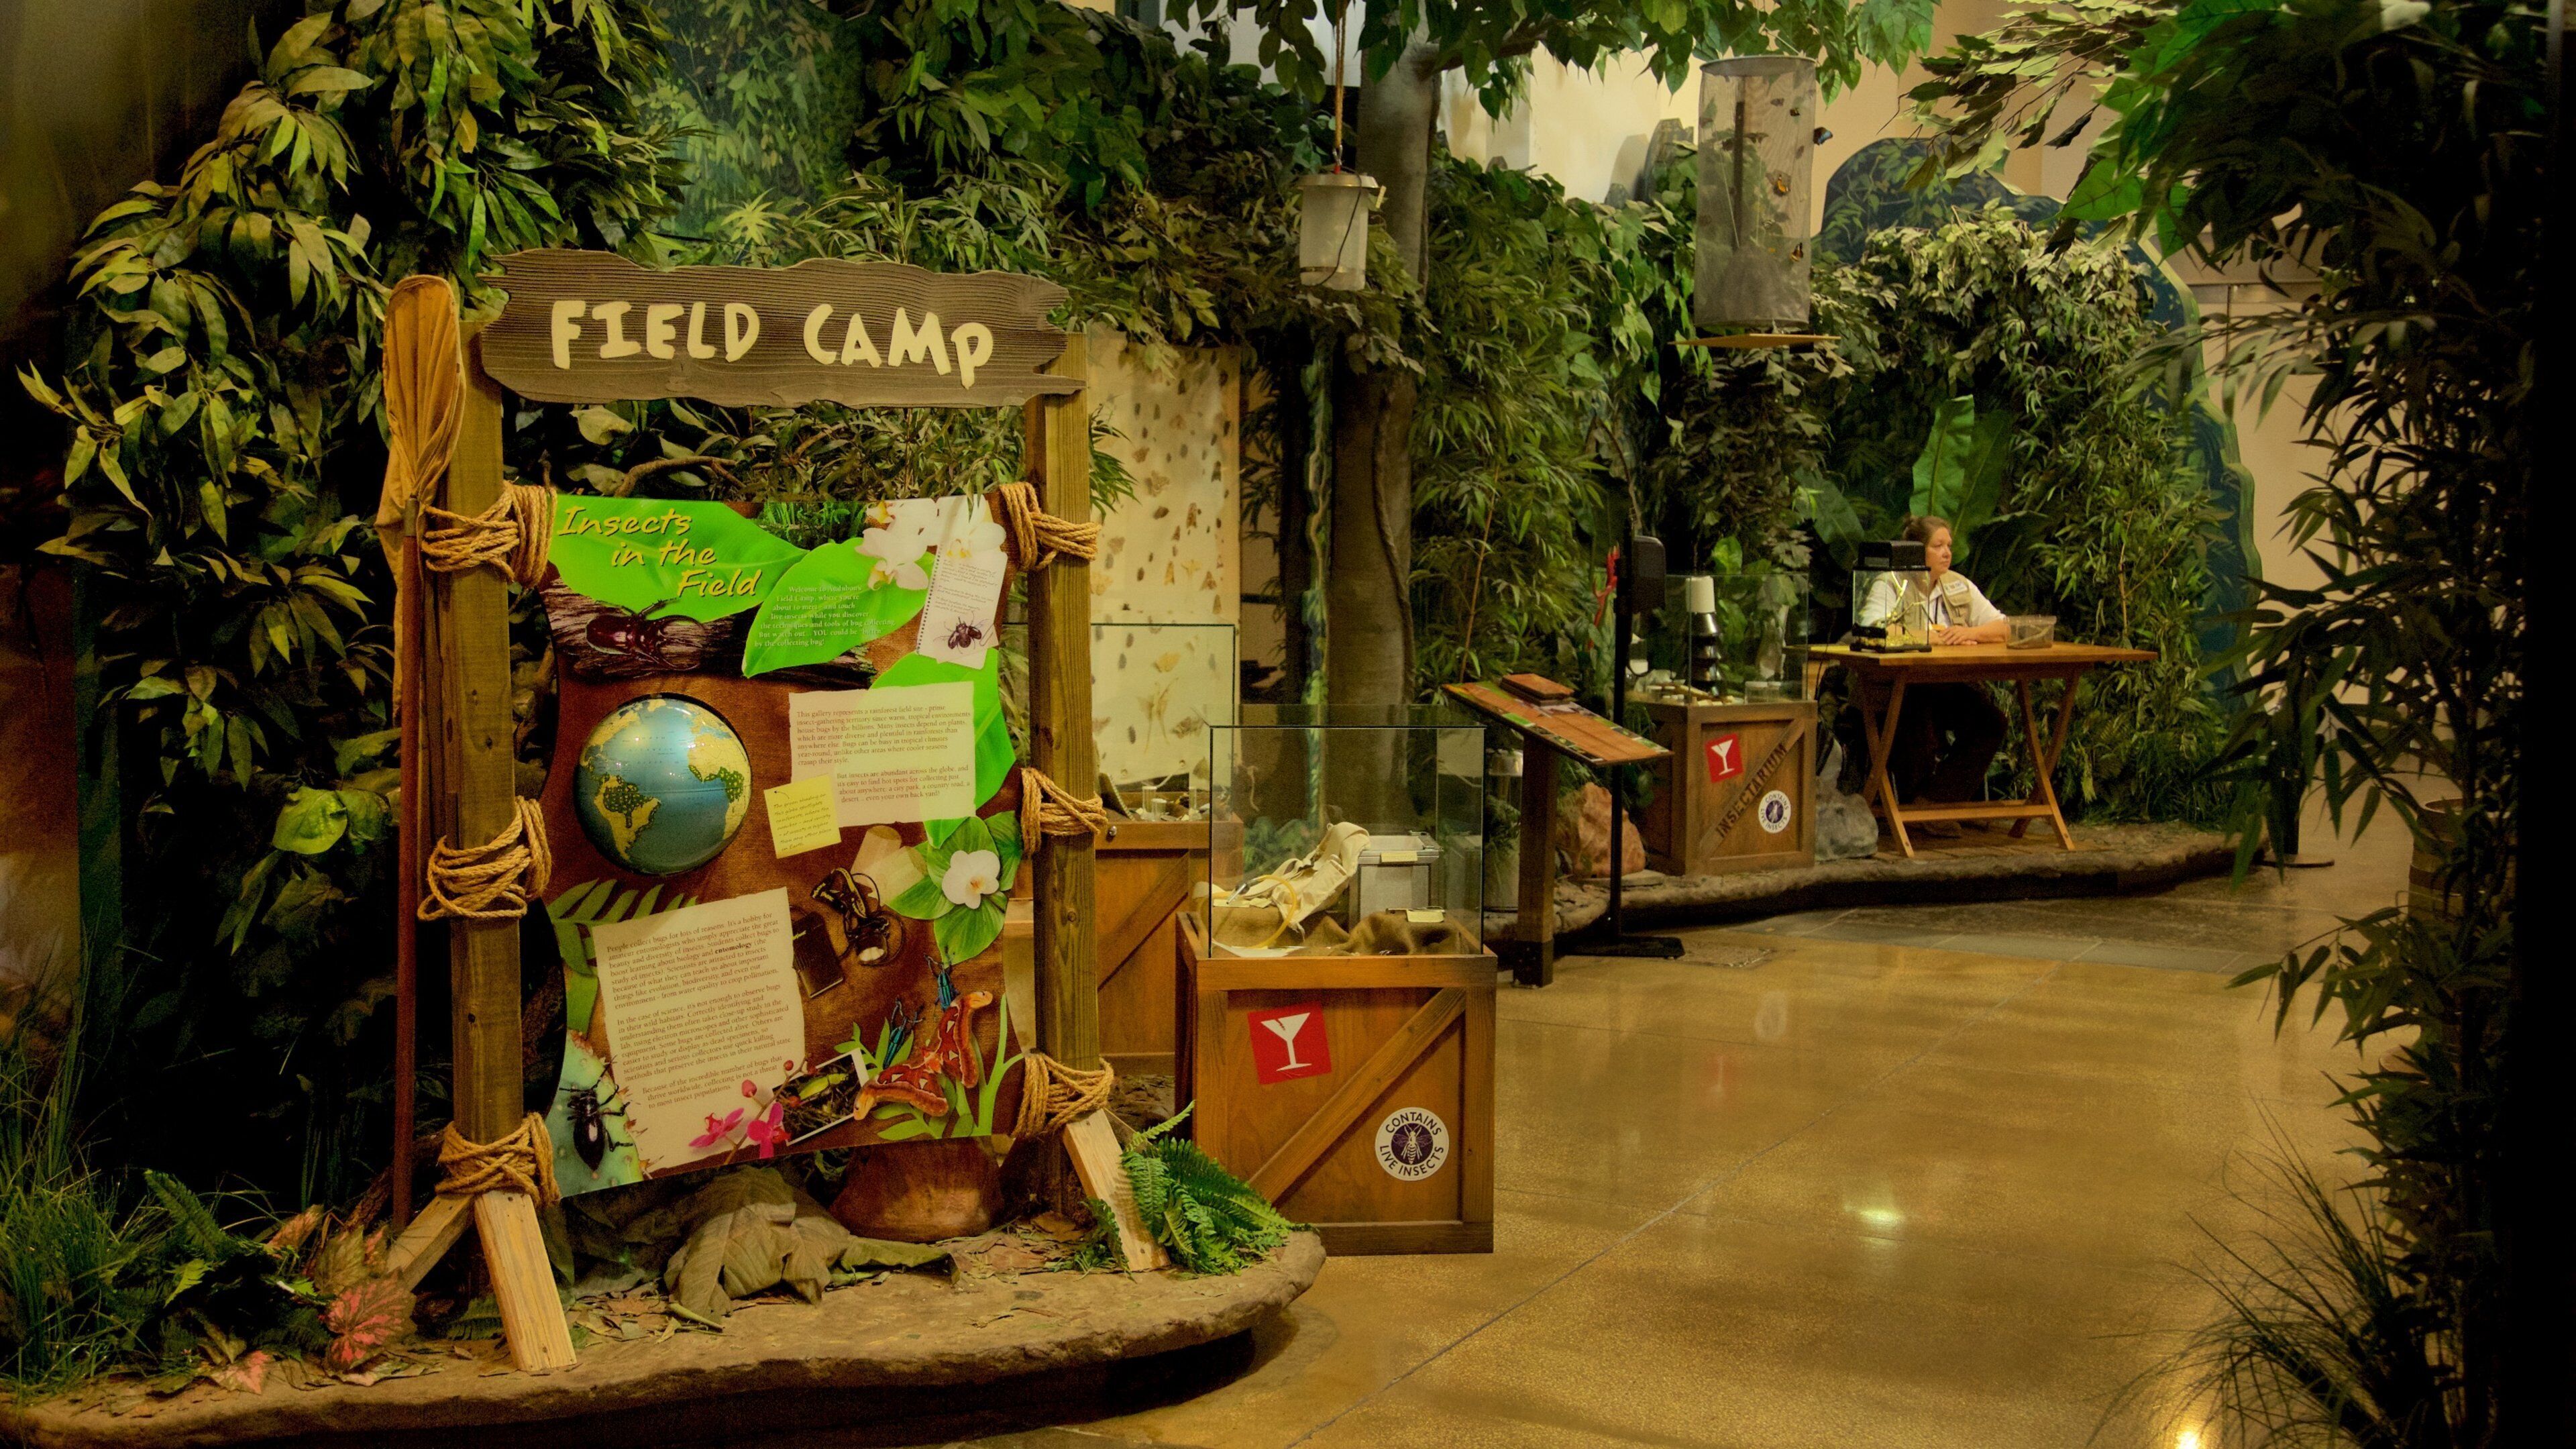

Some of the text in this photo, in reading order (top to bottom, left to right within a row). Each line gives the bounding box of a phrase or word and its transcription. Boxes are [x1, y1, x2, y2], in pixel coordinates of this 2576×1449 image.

[551, 300, 994, 390] FIELD CAMP
[557, 506, 692, 537] Insects
[612, 537, 717, 567] in the
[676, 568, 762, 597] Field
[810, 637, 824, 645] bug!
[916, 720, 937, 728] depend
[1716, 743, 1787, 838] INSECTARIUM
[1766, 793, 1789, 810] CONTAINS
[1766, 816, 1787, 830] INSECTS
[606, 943, 629, 952] People
[629, 938, 651, 947] collect
[742, 915, 762, 923] hobby
[636, 941, 680, 954] entomologists
[697, 932, 717, 941] simply
[719, 926, 750, 937] appreciate
[763, 919, 778, 928] great
[610, 968, 628, 976] boost
[629, 963, 655, 972] learning
[657, 958, 675, 966] about
[676, 953, 699, 961] biology
[714, 942, 752, 953] entomology
[612, 984, 637, 993] because
[692, 966, 709, 975] teach
[719, 961, 737, 969] about
[738, 954, 769, 965] important
[696, 982, 718, 992] quality
[708, 994, 732, 1004] enough
[741, 988, 765, 996] observe
[718, 1009, 745, 1018] close-up
[652, 1032, 678, 1041] electron
[679, 1023, 717, 1035] microscopes
[623, 1063, 652, 1073] scientists
[692, 1046, 721, 1057] collectors
[735, 1038, 752, 1049] quick
[753, 1034, 773, 1042] killing
[642, 1084, 667, 1093] Because
[688, 1071, 719, 1082] incredible
[720, 1065, 745, 1074] number
[1385, 1112, 1442, 1135] CONTAINS
[1380, 1144, 1444, 1177] LIVE INSECTS
